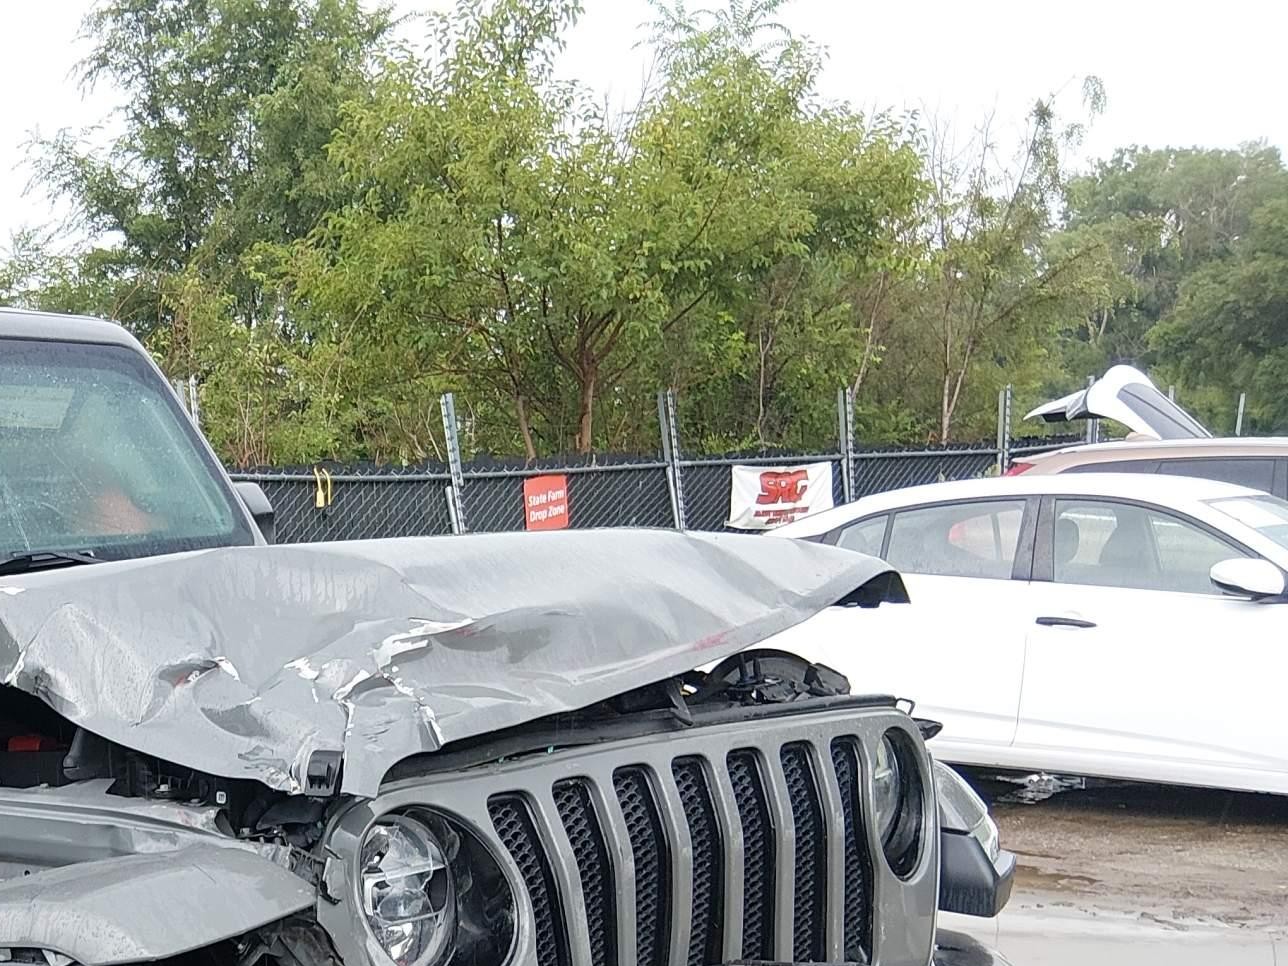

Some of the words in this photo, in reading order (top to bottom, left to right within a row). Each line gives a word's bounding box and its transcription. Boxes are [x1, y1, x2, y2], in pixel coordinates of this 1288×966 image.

[527, 493, 548, 507] State
[529, 509, 548, 522] Drop
[548, 505, 565, 518] Zone
